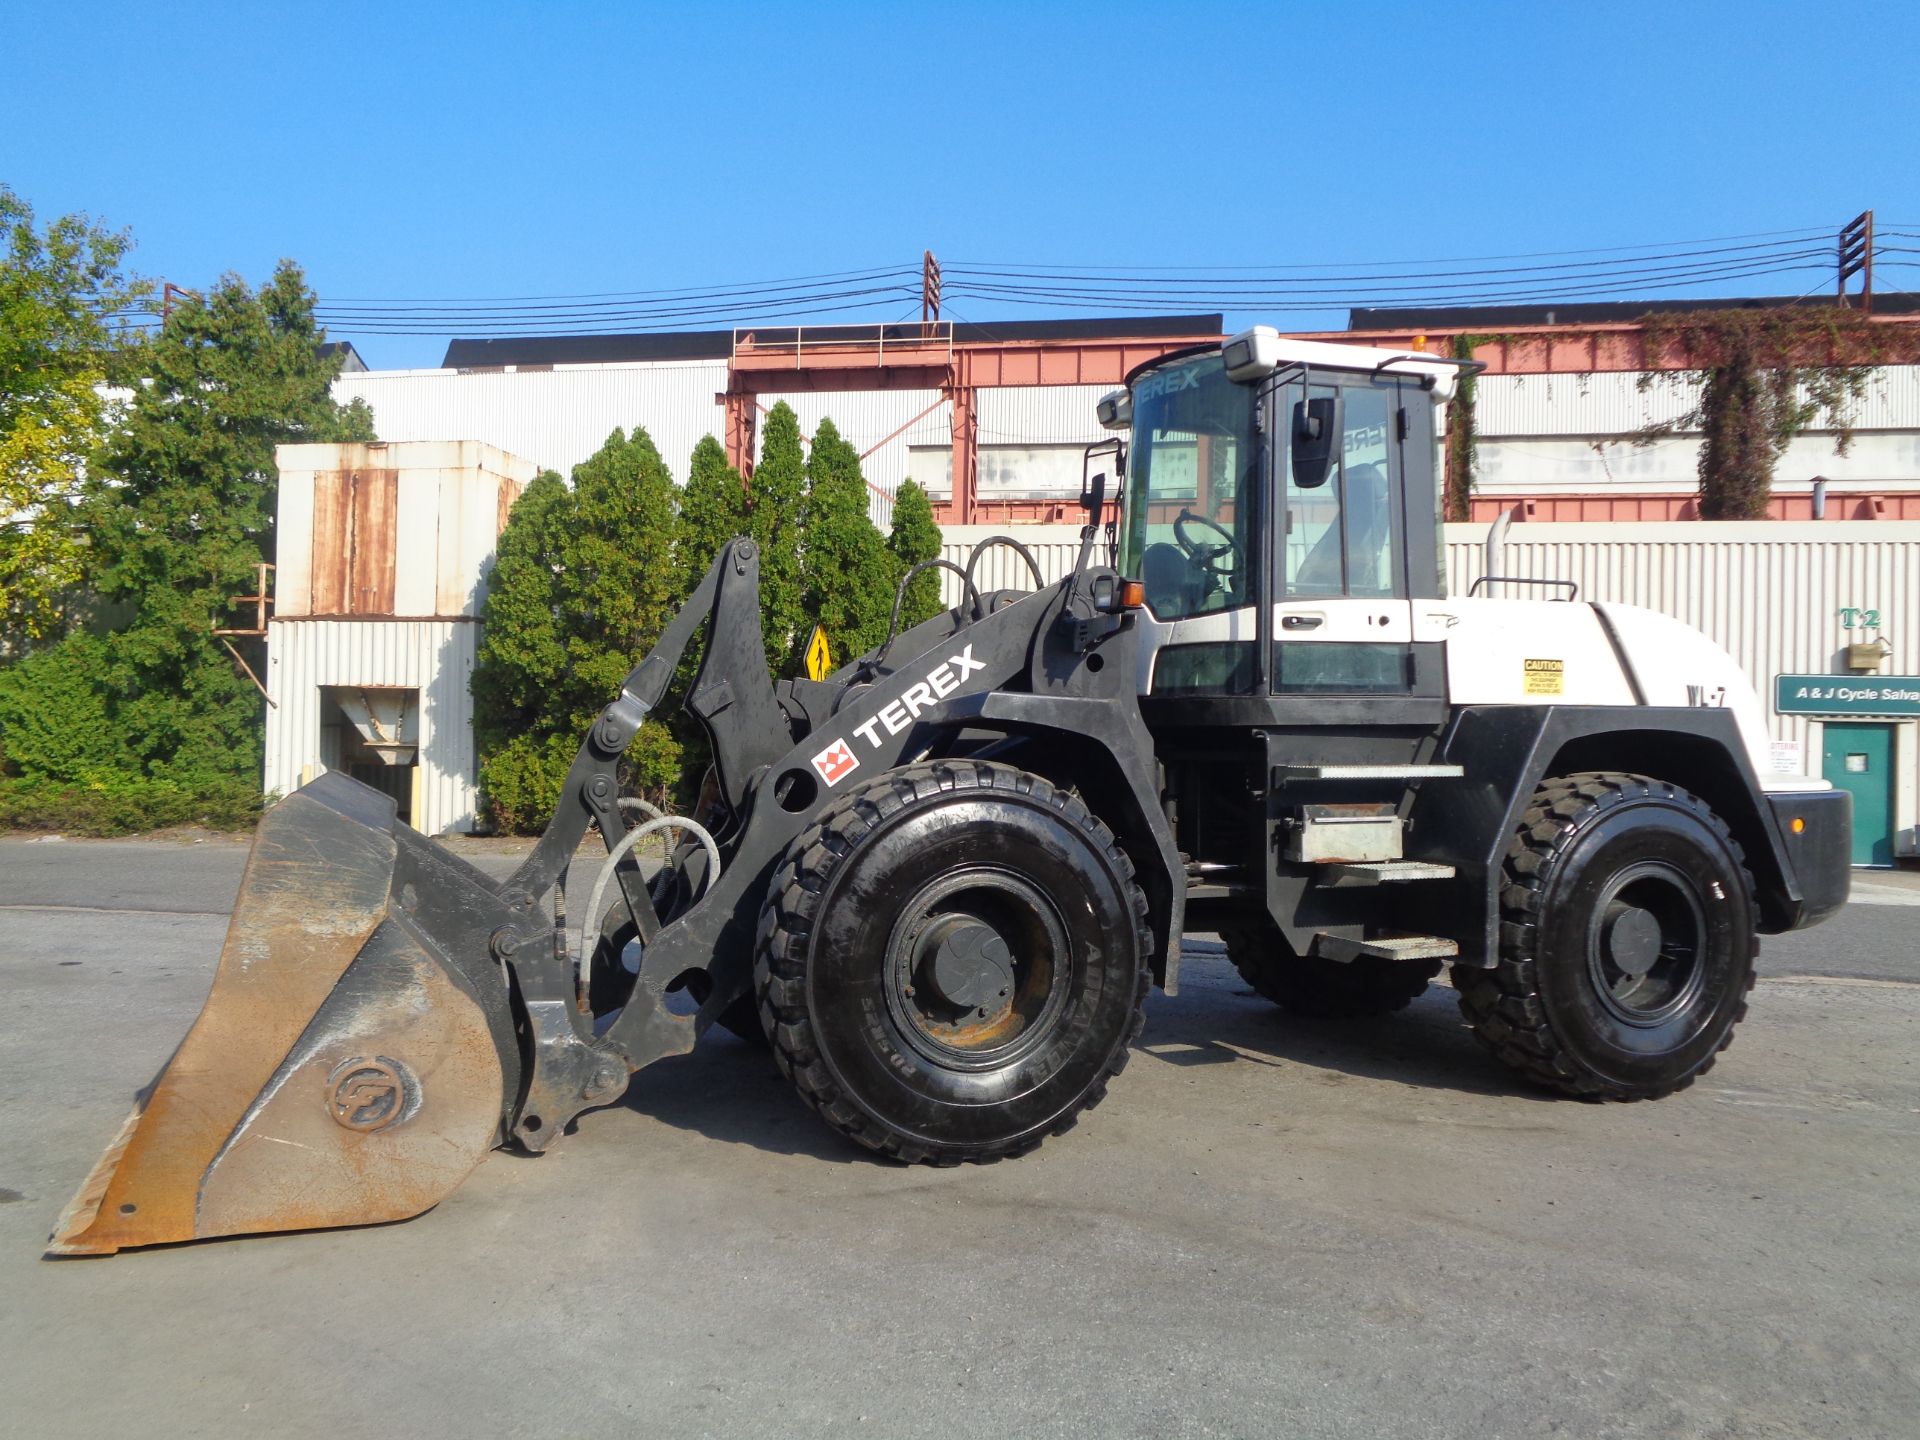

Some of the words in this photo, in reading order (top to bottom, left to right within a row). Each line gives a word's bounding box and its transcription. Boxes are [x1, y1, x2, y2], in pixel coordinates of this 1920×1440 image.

[1142, 368, 1199, 404] EREX
[1840, 608, 1880, 627] T2
[1525, 661, 1563, 670] CAUTION
[852, 643, 987, 749] TEREX
[1796, 687, 1808, 698] A
[1810, 688, 1821, 698] &
[1824, 688, 1835, 698] J
[1838, 688, 1878, 701] Cycle
[1881, 689, 1920, 703] Salva
